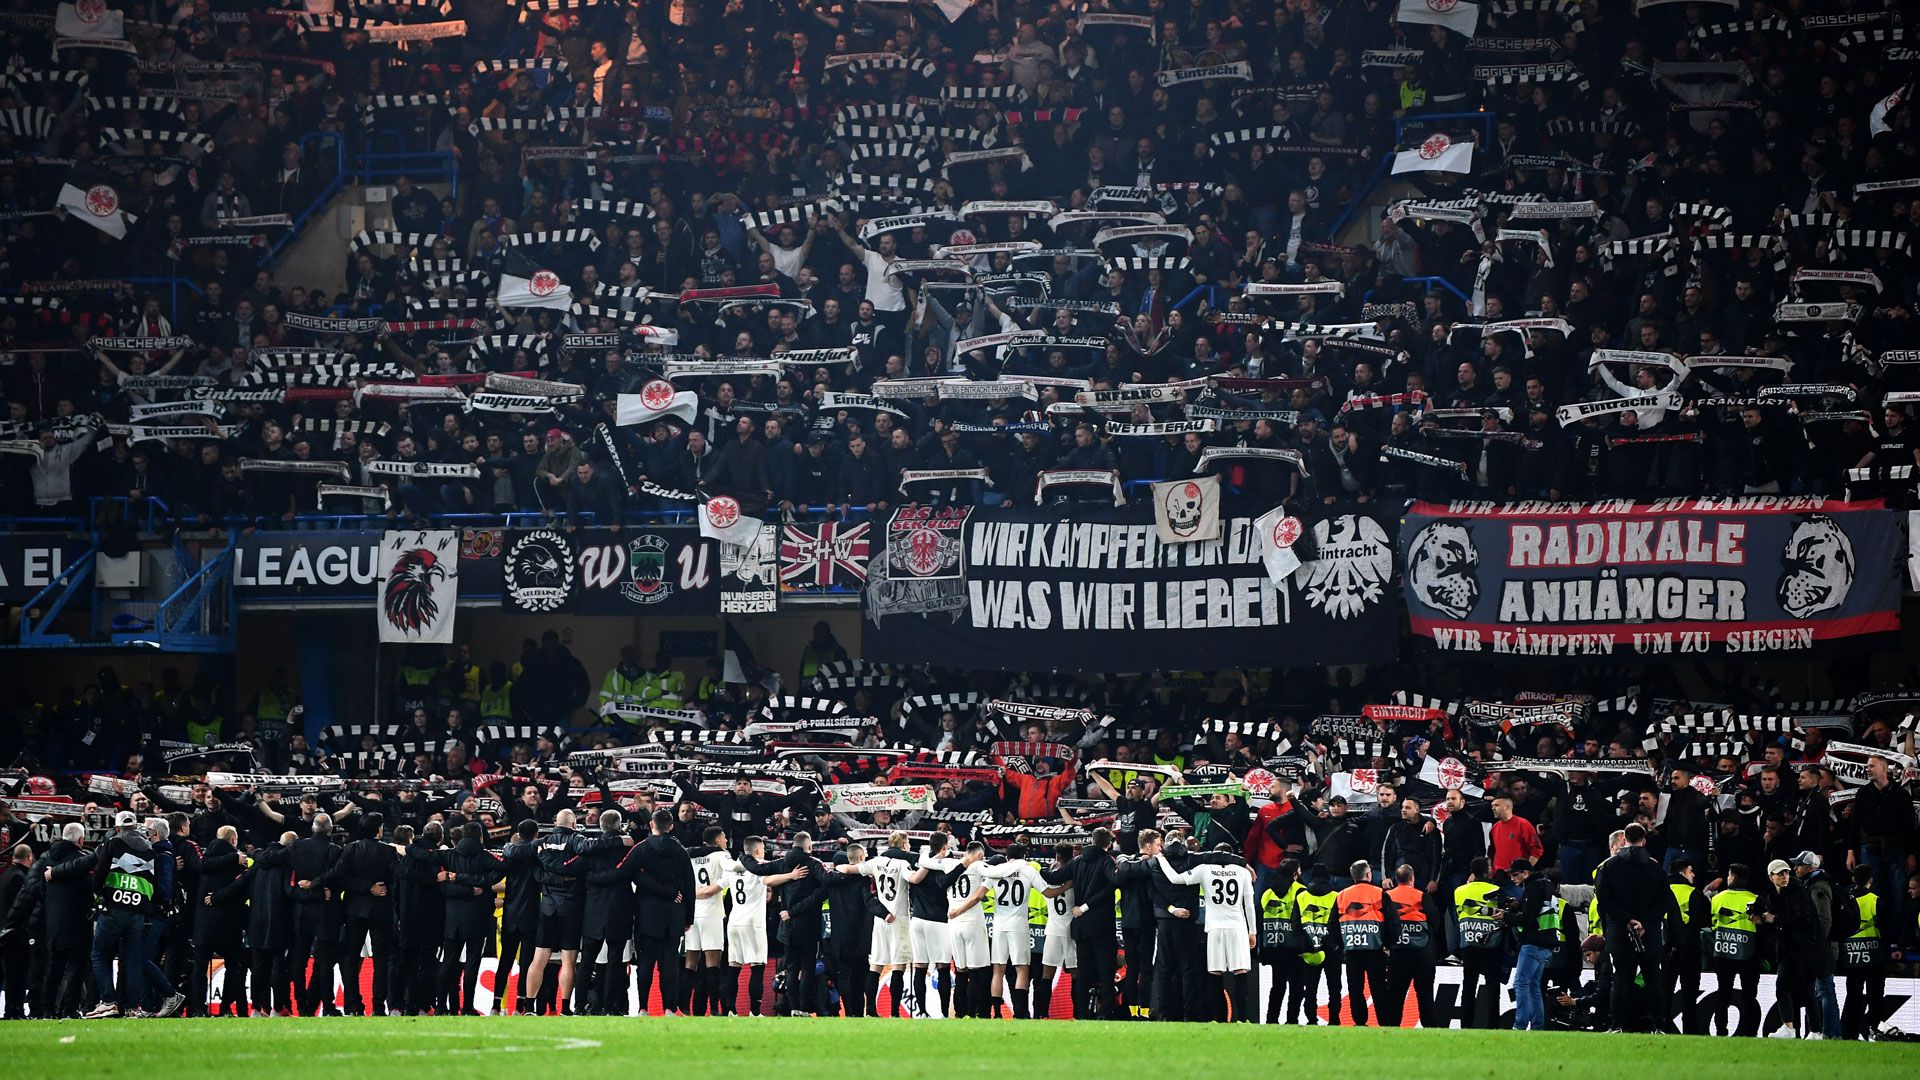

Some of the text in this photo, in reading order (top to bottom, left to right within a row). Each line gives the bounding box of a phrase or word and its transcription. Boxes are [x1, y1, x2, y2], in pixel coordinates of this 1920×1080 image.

[1175, 64, 1239, 79] Eintracht
[1058, 335, 1106, 348] Frankfurt
[960, 384, 991, 394] EINTRACHT
[1095, 388, 1163, 401] INFERNO
[1579, 392, 1681, 415] Eintracht 12
[1449, 499, 1496, 515] WIR
[1499, 499, 1588, 515] LEBEN
[1647, 496, 1689, 513] ZU
[971, 521, 1029, 568] WIR
[1228, 517, 1266, 566] DA
[1511, 522, 1746, 566] RADIKALE
[797, 538, 854, 564] SHW
[233, 546, 378, 587] LEAGU
[733, 591, 777, 601] UNSEREN
[1500, 568, 1745, 621] ANHÄNGER
[720, 601, 777, 614] HERZEN!
[968, 577, 1290, 631] WAS WIR LIEBEN
[1432, 627, 1815, 656] WIR KÄMPFEN UM ZU SIEGEN
[614, 702, 696, 719] Eintracht
[1371, 706, 1428, 720] EINTRACHT
[1470, 703, 1541, 719] MAGISCHE
[1030, 836, 1057, 846] ULTRAS
[119, 875, 139, 890] HB
[877, 874, 896, 901] 13
[112, 890, 142, 906] 059
[736, 879, 746, 905] 8
[997, 881, 1025, 907] 20
[1211, 879, 1238, 905] 39
[1054, 895, 1066, 915] 6
[1341, 924, 1379, 935] STEWARD
[1345, 935, 1369, 946] 281
[1714, 942, 1738, 955] 085
[1847, 952, 1871, 963] 775
